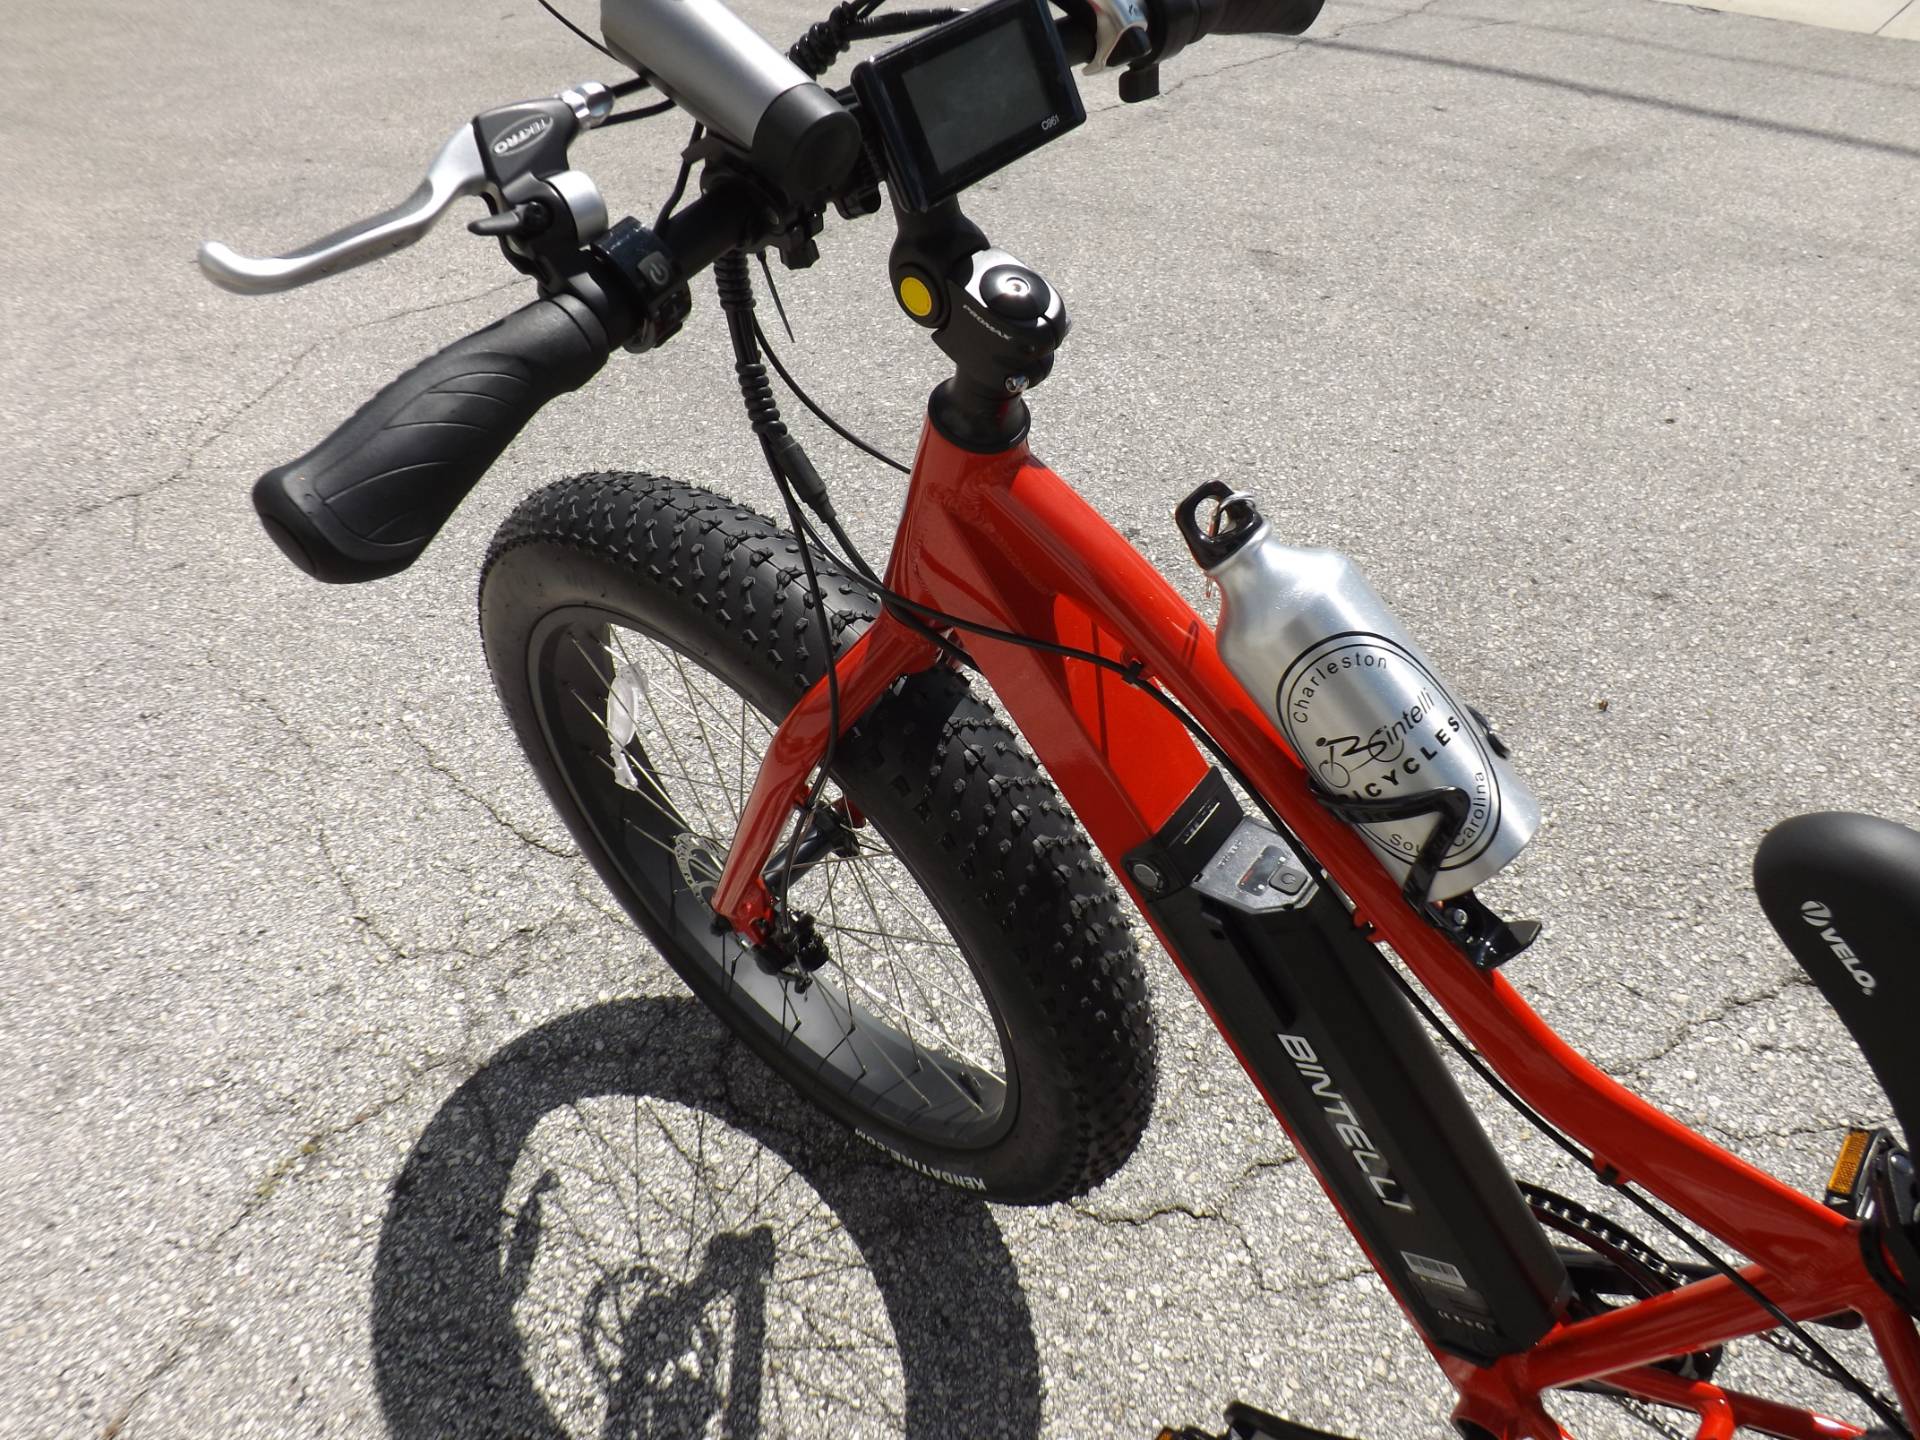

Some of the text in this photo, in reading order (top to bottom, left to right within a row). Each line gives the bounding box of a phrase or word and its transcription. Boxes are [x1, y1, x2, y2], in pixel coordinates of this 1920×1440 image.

[494, 118, 546, 154] TEKTRO
[1293, 651, 1388, 723] Charleston
[1336, 716, 1460, 800] ICYCLES
[1453, 772, 1486, 847] Carolina
[1820, 927, 1876, 988] VELO
[1277, 1033, 1414, 1214] BINTELLI
